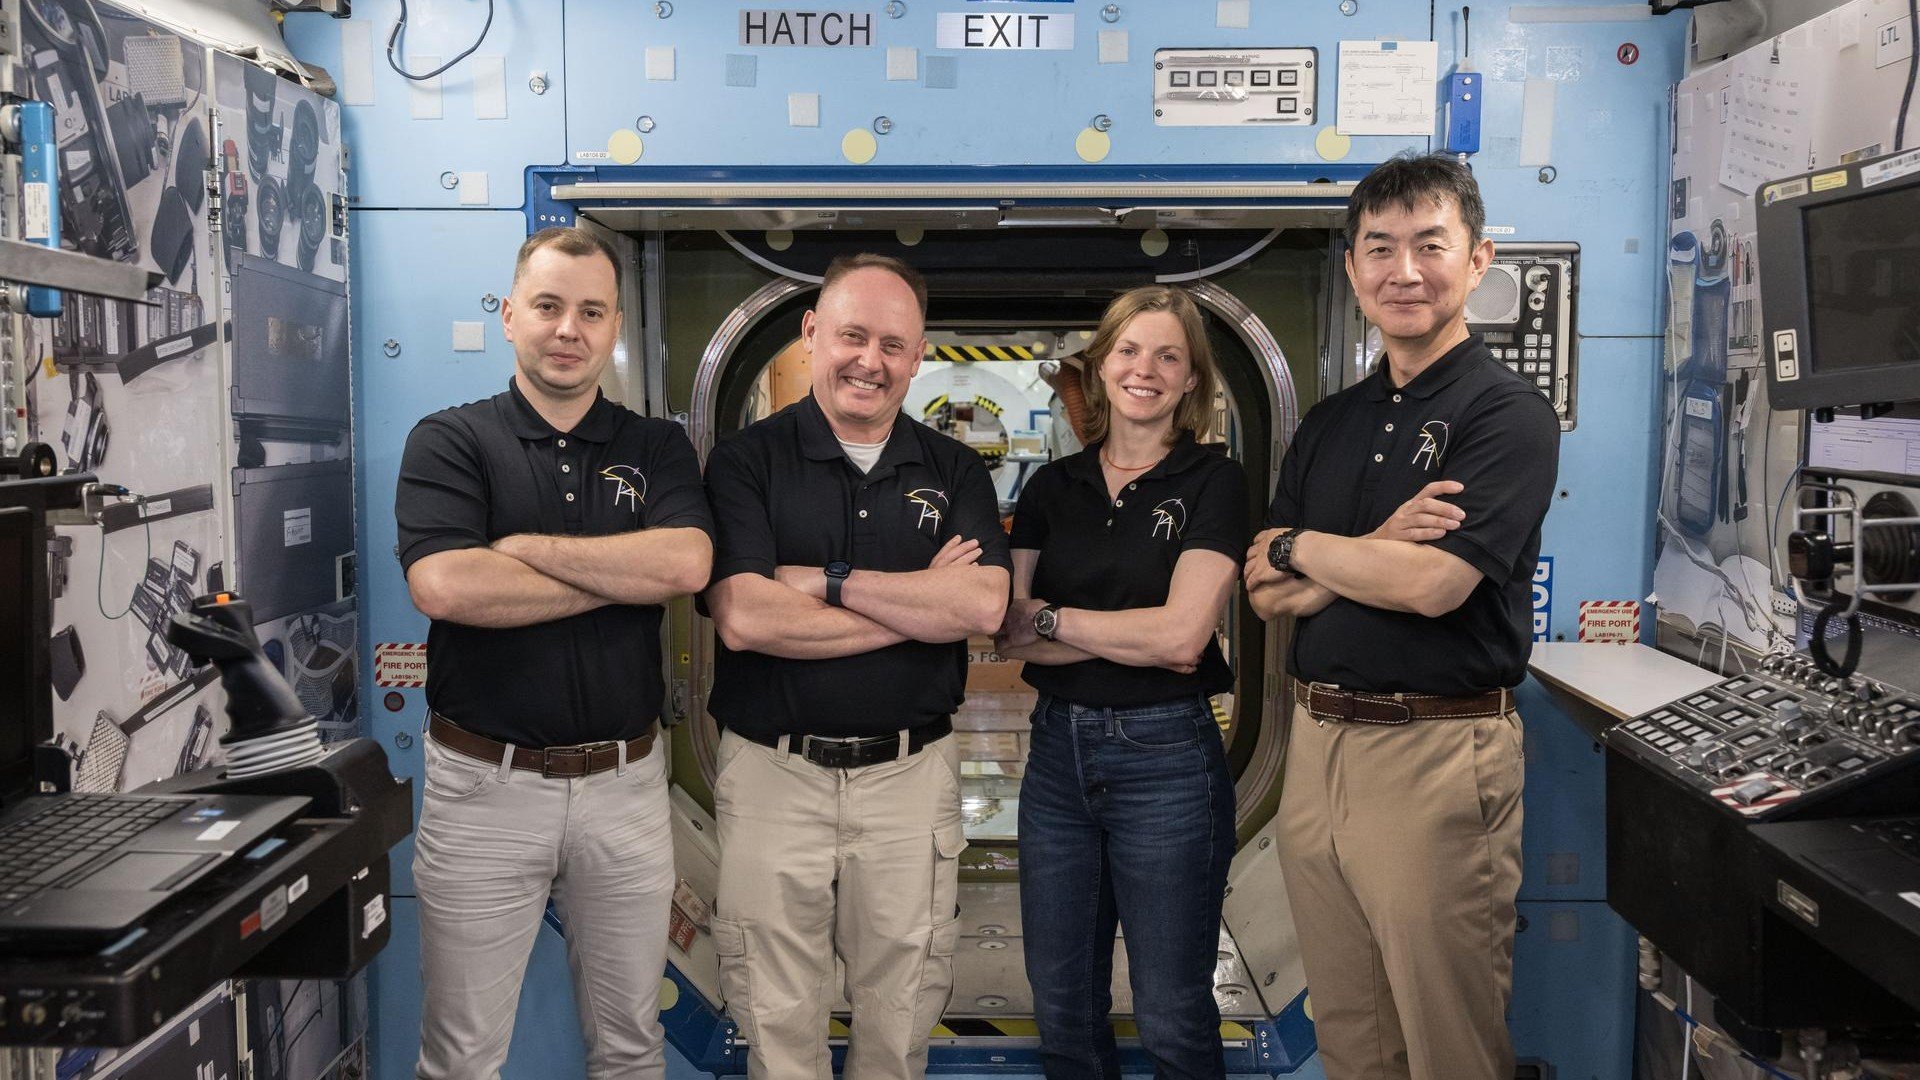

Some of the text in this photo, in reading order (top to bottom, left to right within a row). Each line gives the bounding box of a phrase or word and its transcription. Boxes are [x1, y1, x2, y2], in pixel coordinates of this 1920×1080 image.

[745, 12, 871, 46] HATCH
[964, 14, 1049, 48] EXIT
[1881, 25, 1901, 47] LTL
[1587, 619, 1632, 628] FIRE PORT
[383, 662, 426, 670] FIRE PORT
